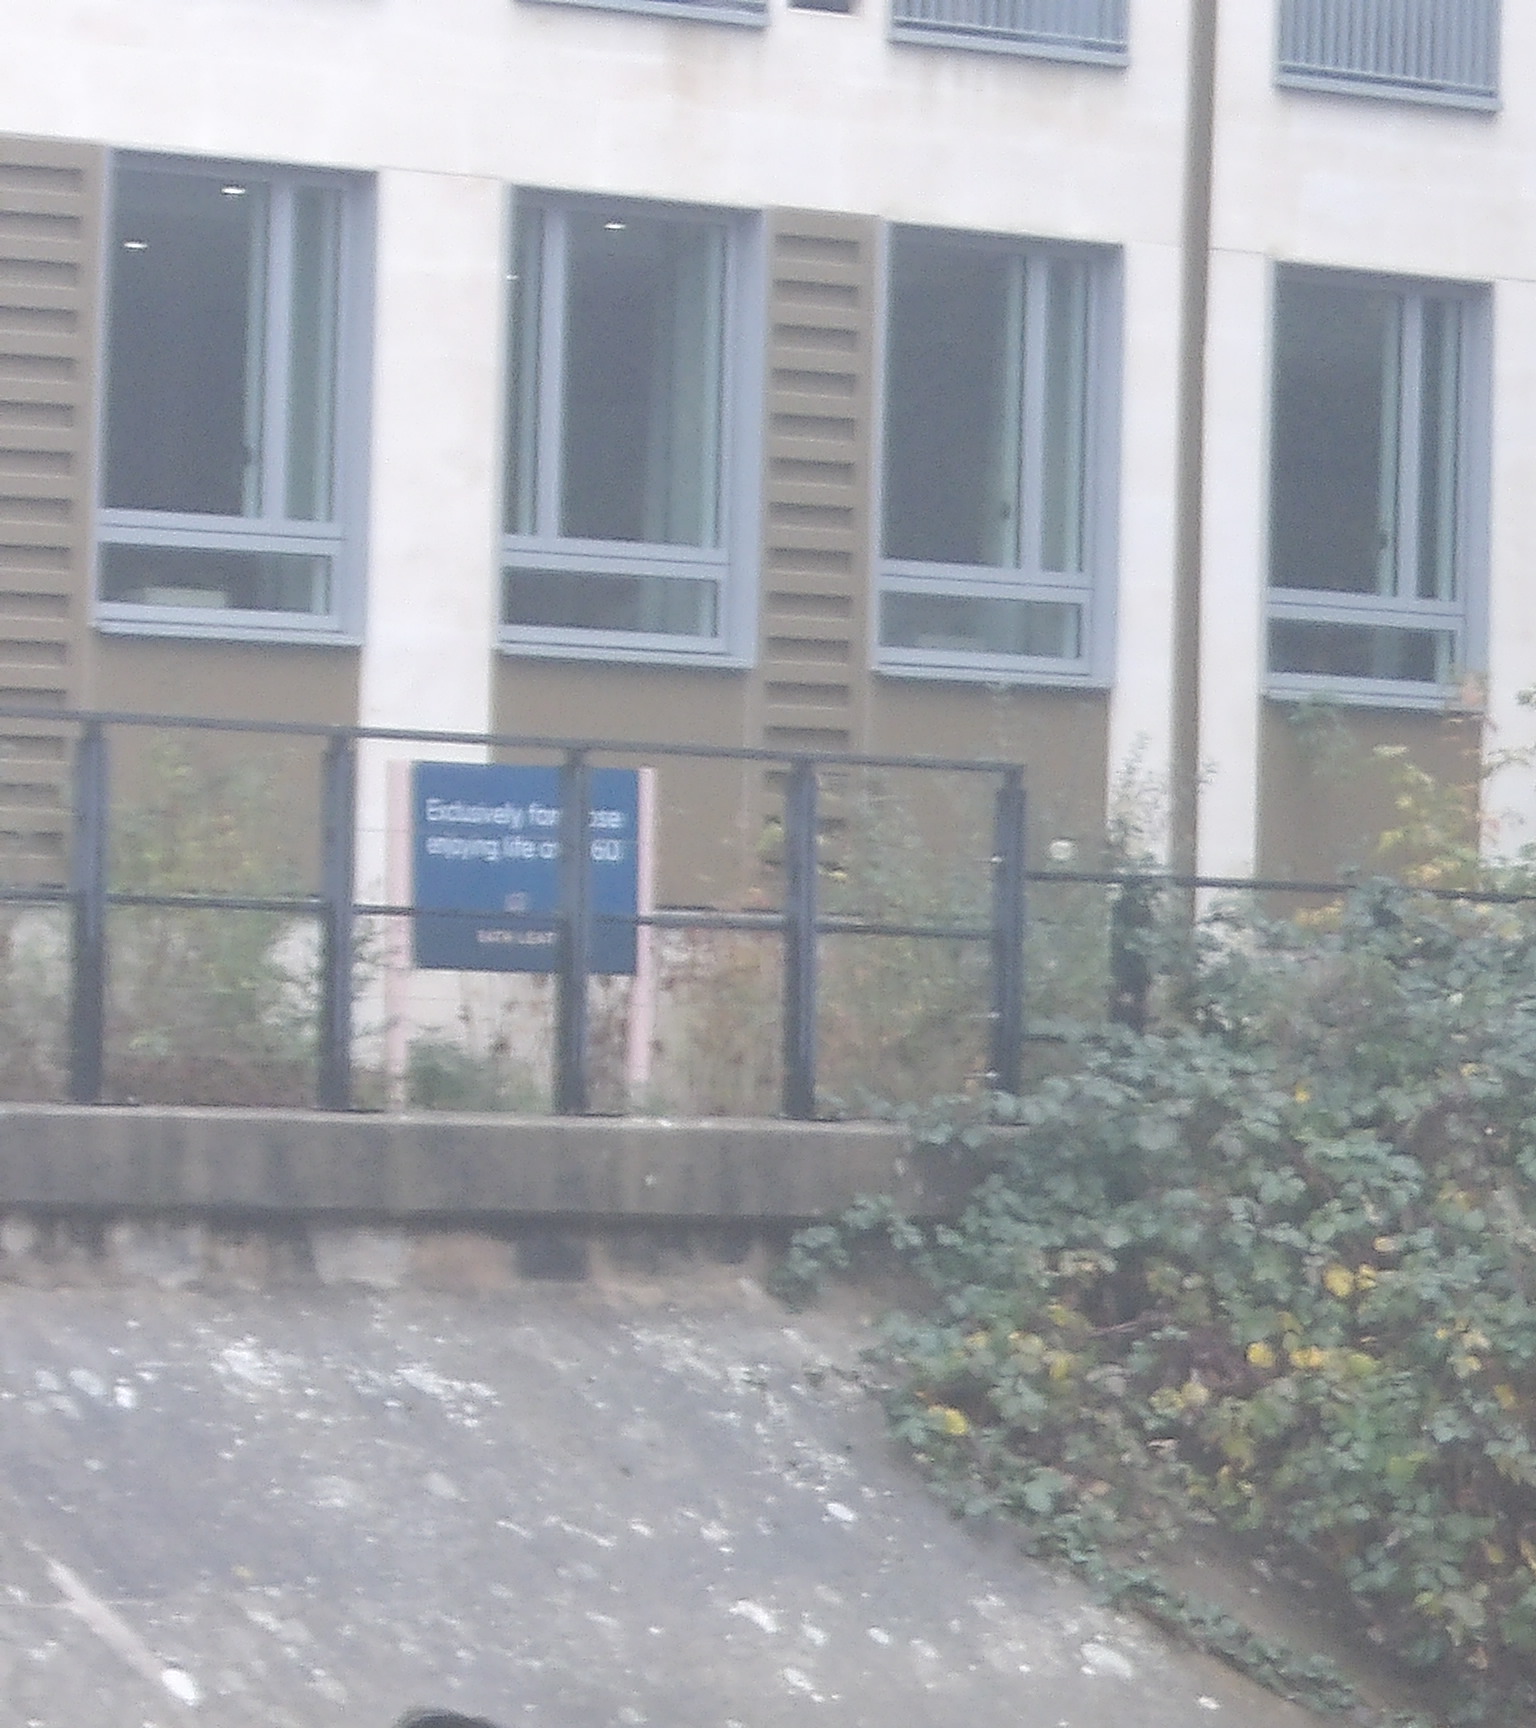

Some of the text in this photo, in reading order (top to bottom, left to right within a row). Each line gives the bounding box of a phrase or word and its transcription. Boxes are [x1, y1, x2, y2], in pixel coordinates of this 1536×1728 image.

[424, 797, 522, 831] Exclusively
[425, 836, 500, 863] enjoying
[502, 834, 535, 860] life
[590, 838, 621, 862] 60
